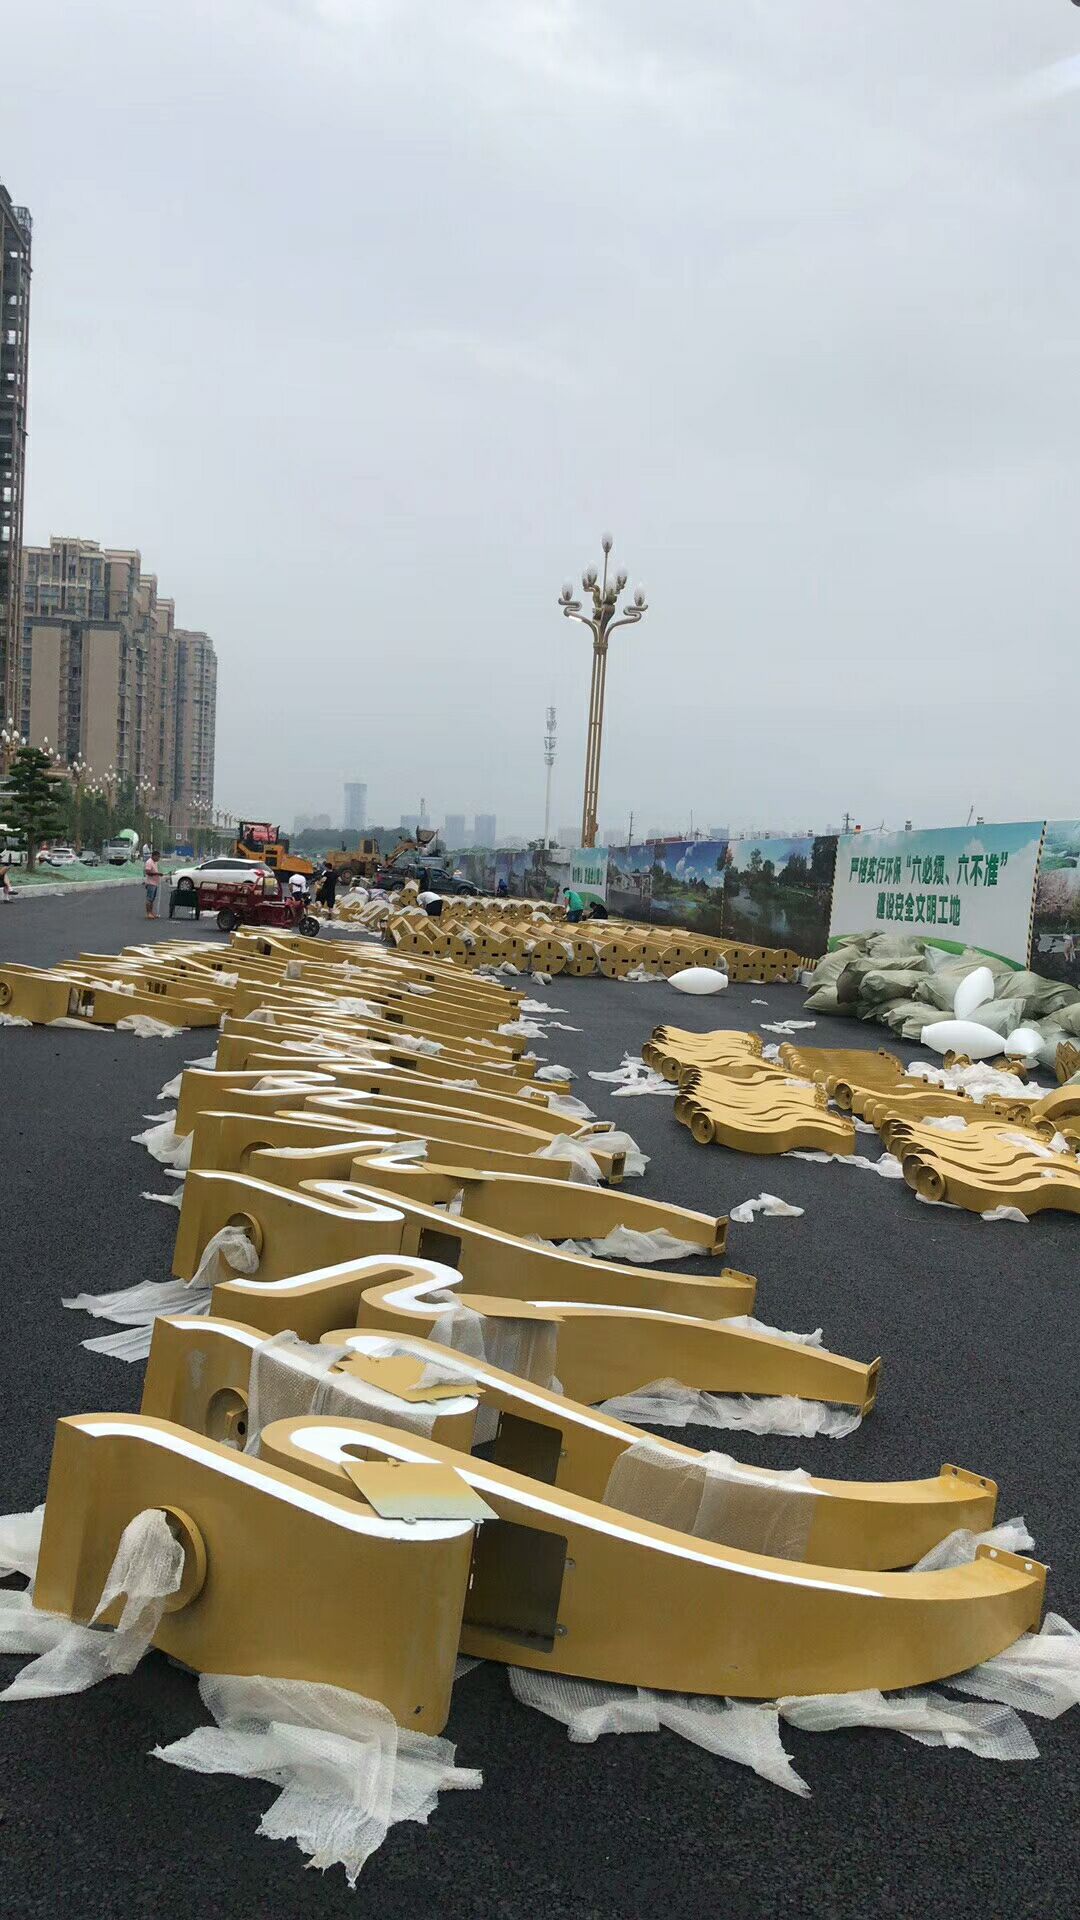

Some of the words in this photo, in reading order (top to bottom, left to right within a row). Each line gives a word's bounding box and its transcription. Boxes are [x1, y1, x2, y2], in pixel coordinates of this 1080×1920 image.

[876, 892, 961, 926] 建设安全文明工地
